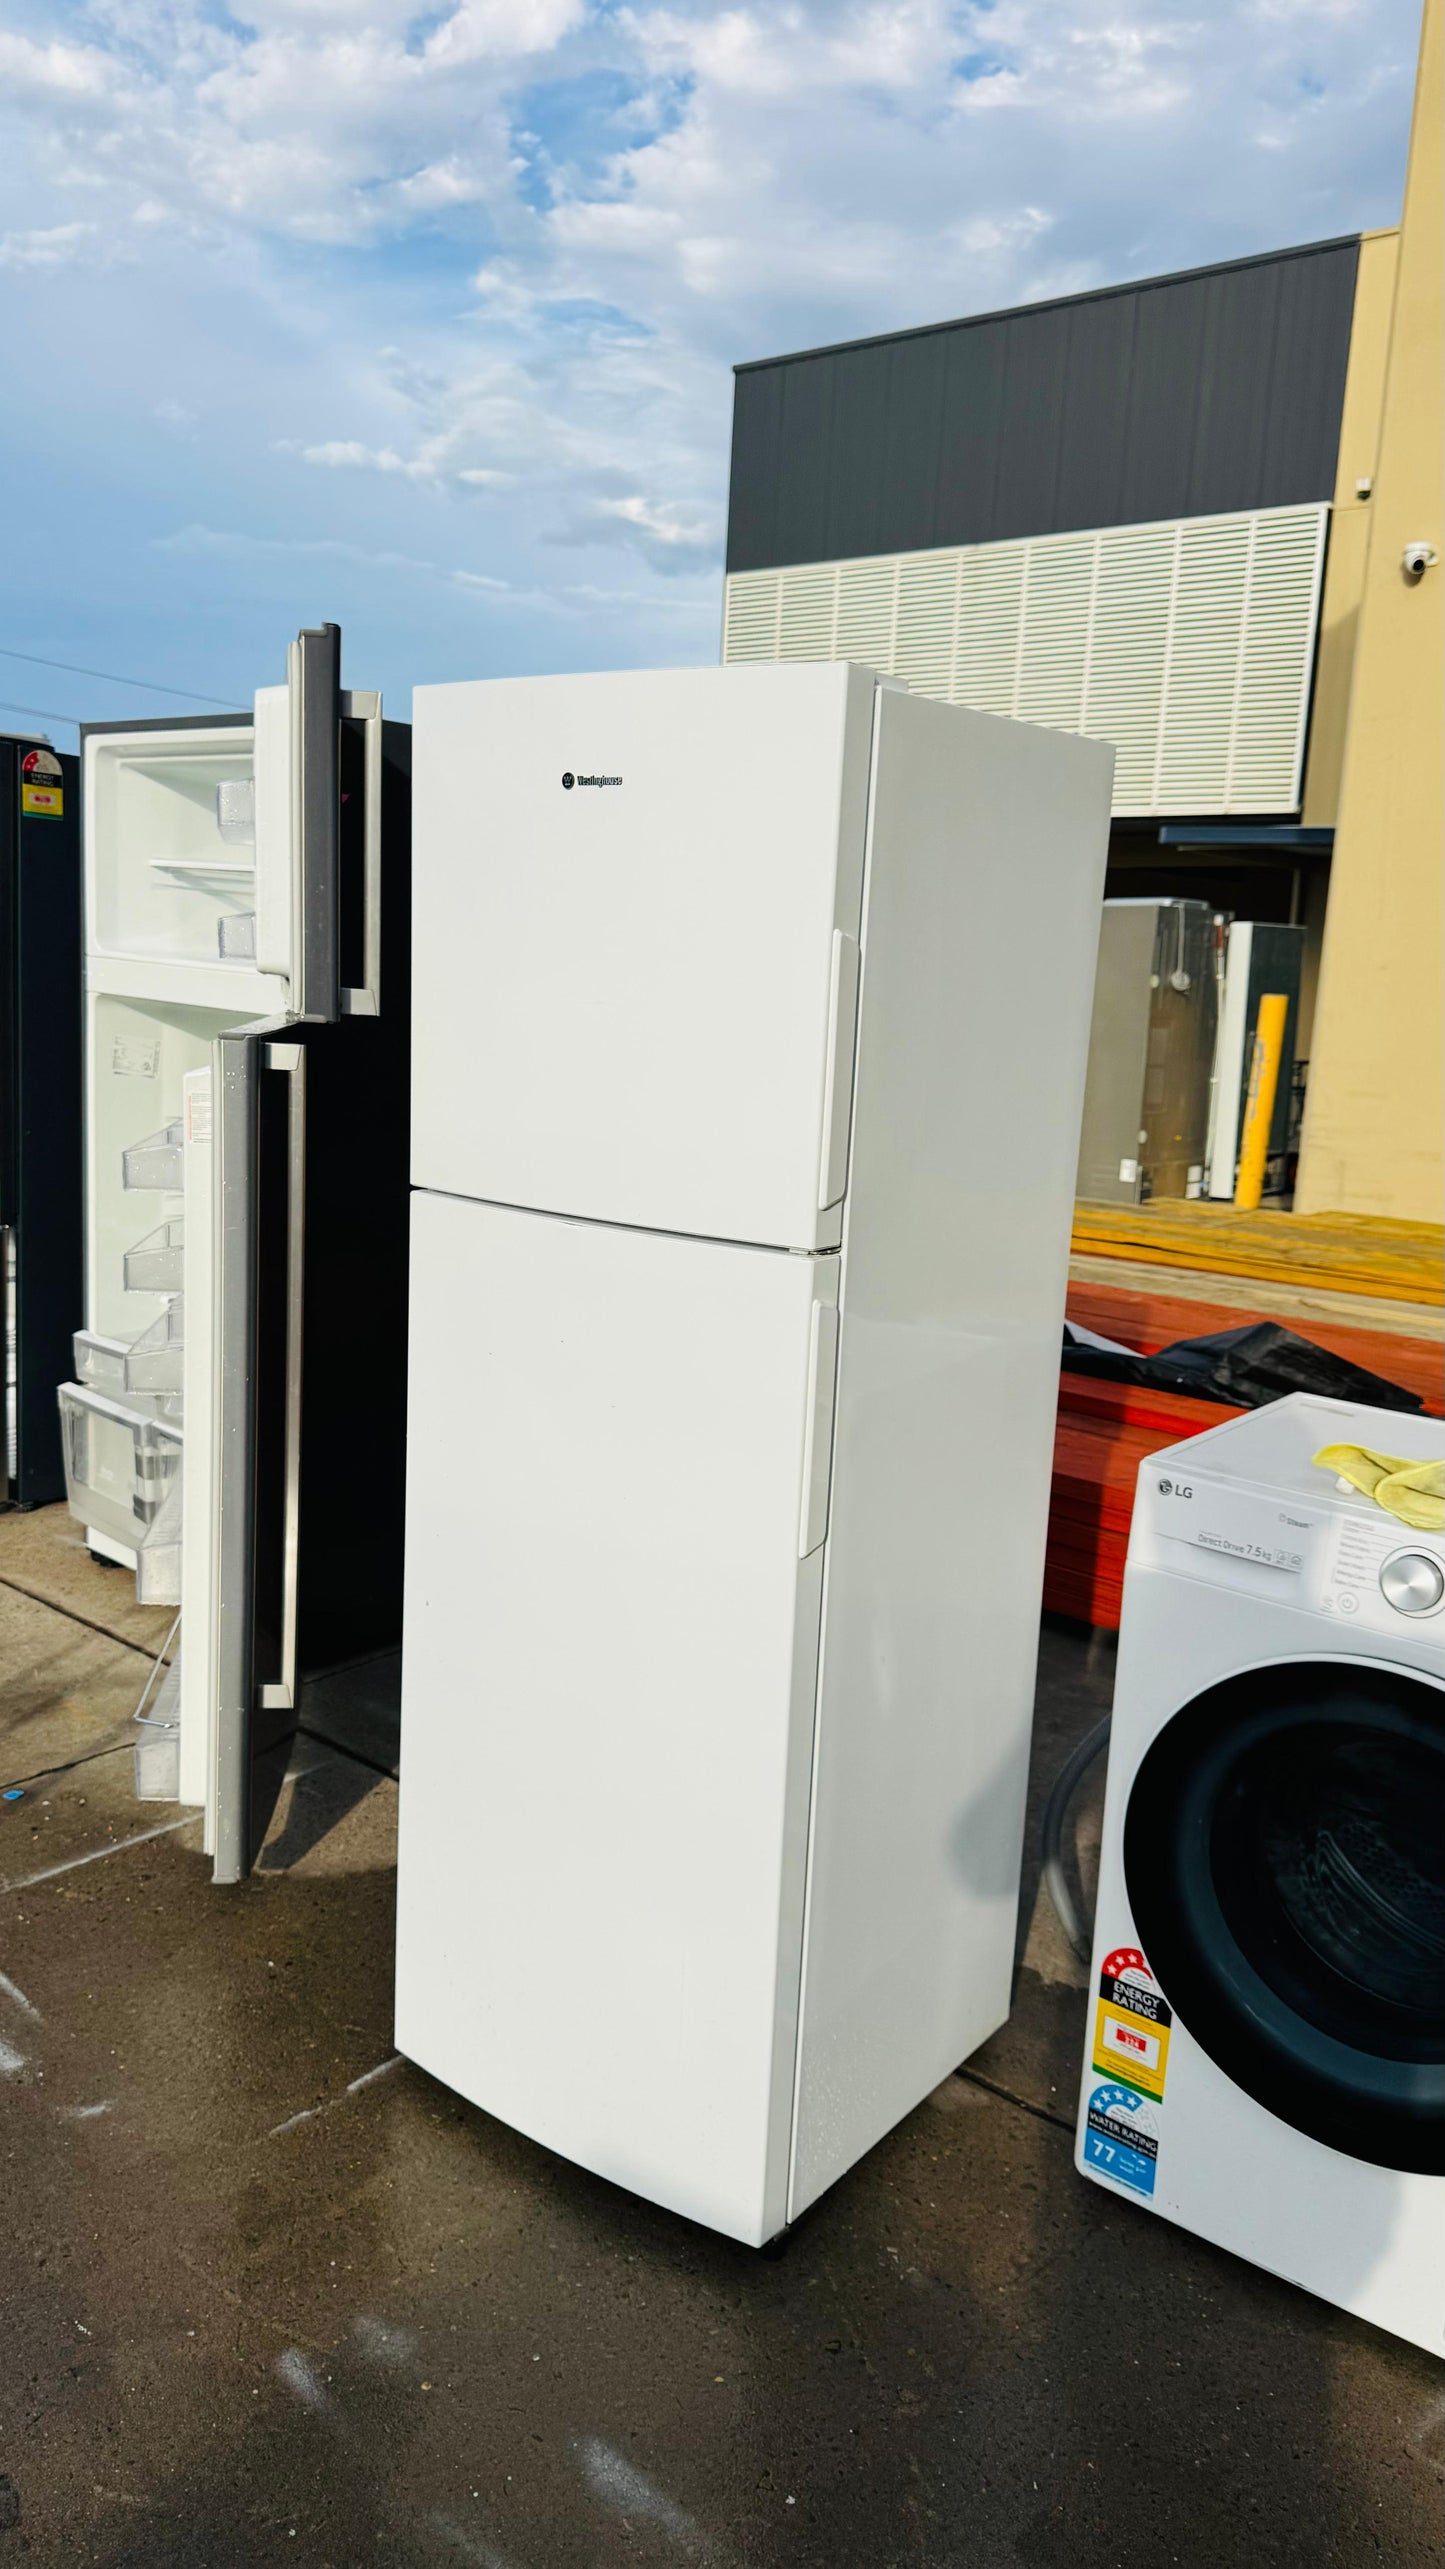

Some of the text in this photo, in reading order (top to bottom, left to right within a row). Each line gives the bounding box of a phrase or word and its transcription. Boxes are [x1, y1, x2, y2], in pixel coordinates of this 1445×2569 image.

[577, 775, 623, 788] Westinghouse
[1175, 1484, 1193, 1499] LG
[1198, 1533, 1222, 1548] Direct
[1223, 1540, 1245, 1554] Drive
[1246, 1544, 1262, 1557] 7.5
[1262, 1552, 1272, 1562] kg
[1112, 1992, 1157, 2020] RATING
[1113, 1981, 1160, 2008] ENERGY
[1089, 2111, 1120, 2134] WATER
[1121, 2127, 1157, 2152] RATING
[1093, 2139, 1116, 2163] 77
